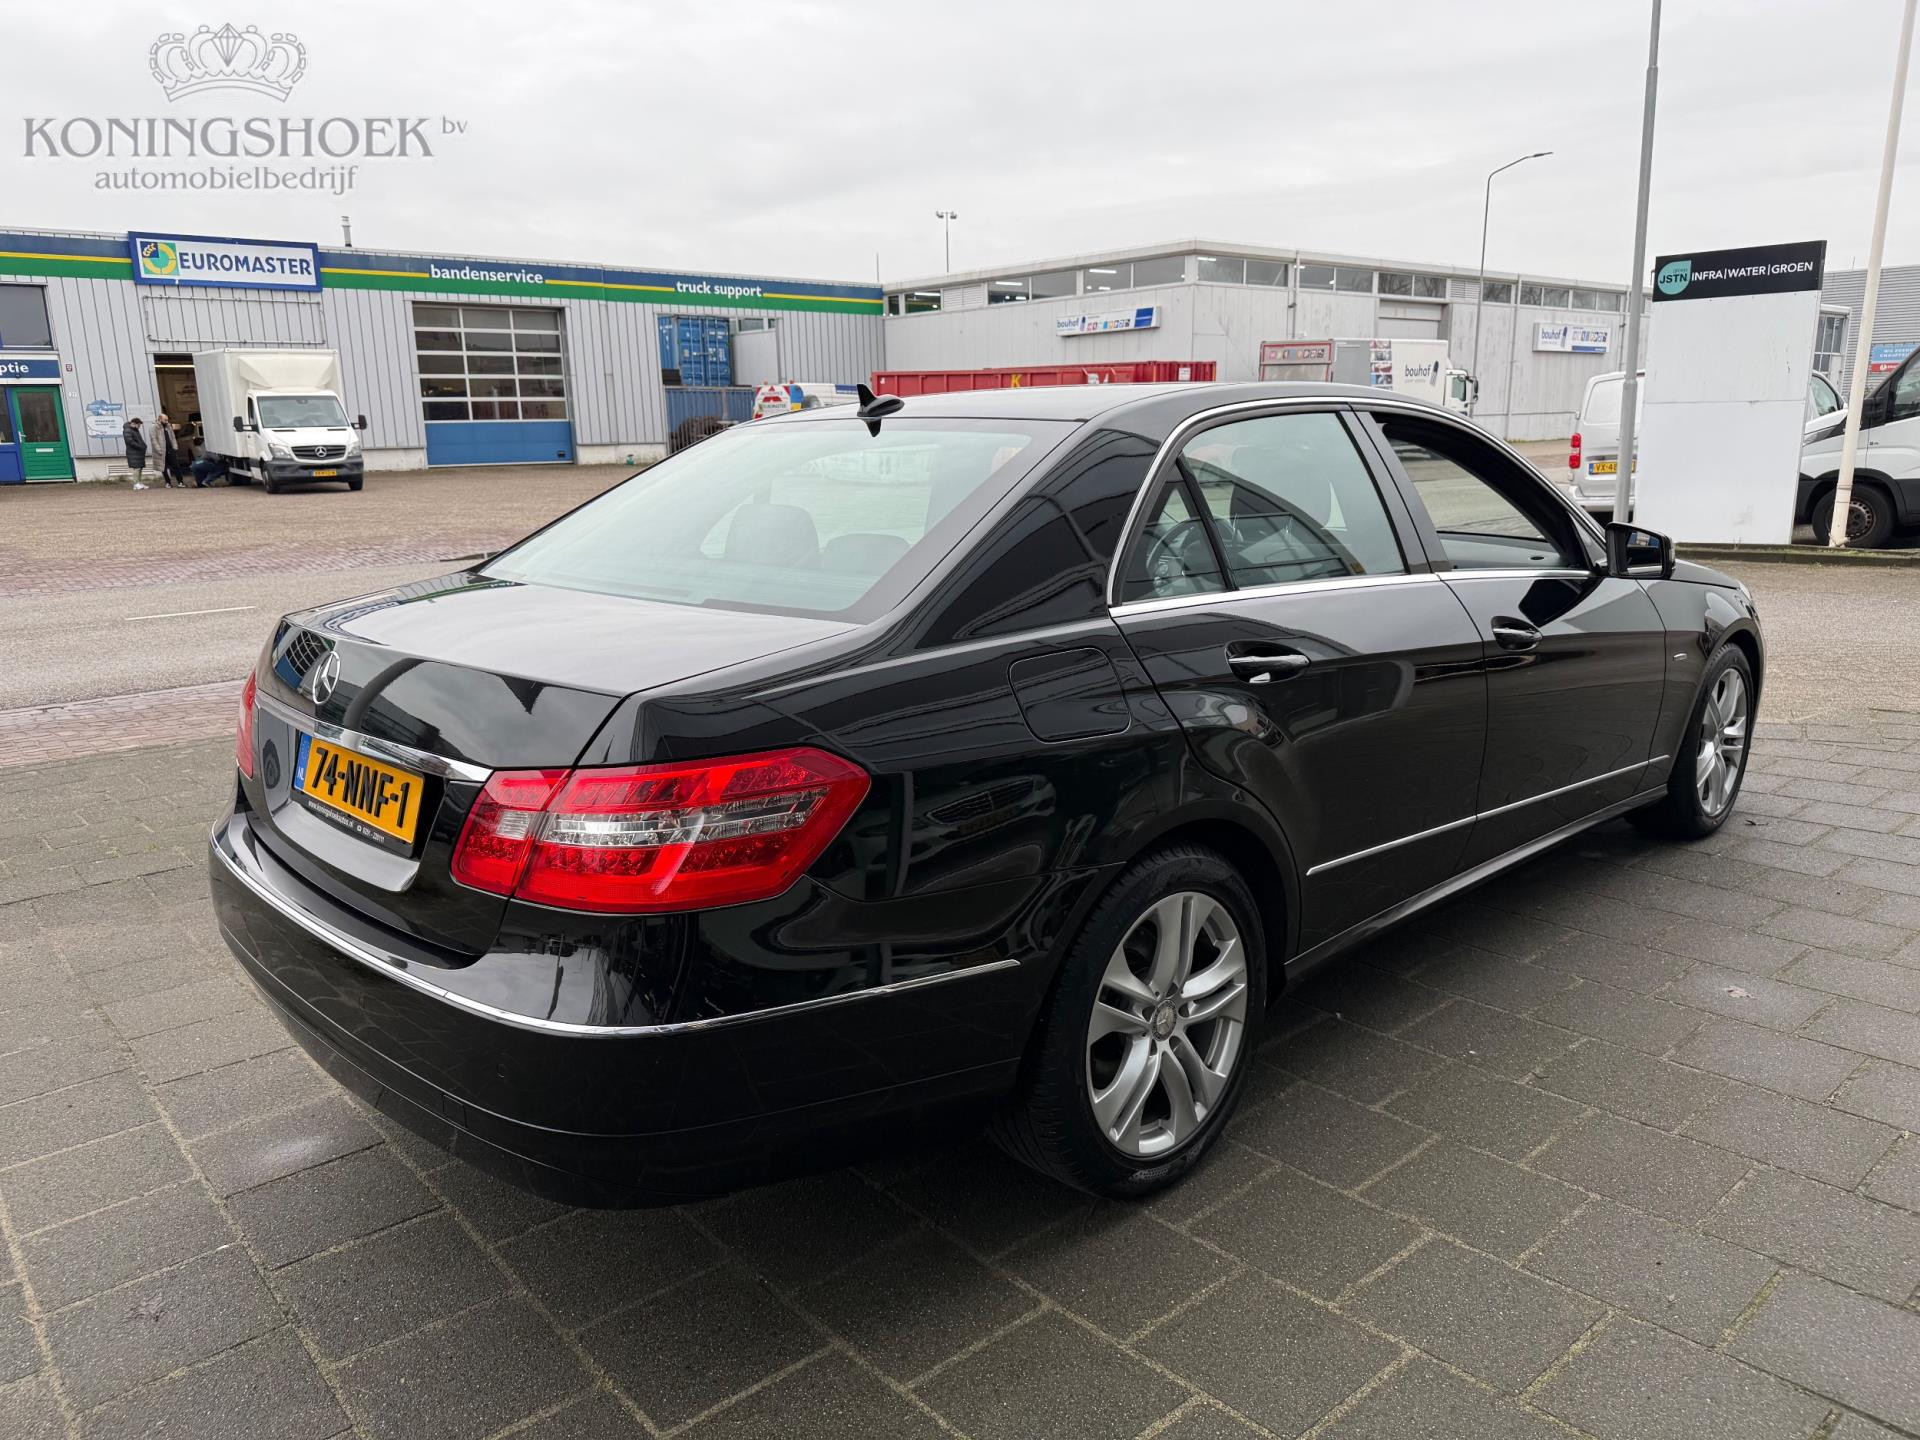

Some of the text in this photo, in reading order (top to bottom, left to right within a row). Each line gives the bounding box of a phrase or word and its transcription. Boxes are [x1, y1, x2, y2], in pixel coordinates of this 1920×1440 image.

[178, 251, 313, 276] EUROMASTER
[430, 263, 544, 284] bandenservice
[1659, 273, 1688, 284] JSTN
[676, 281, 762, 299] truck support
[0, 362, 29, 374] ptie
[311, 746, 411, 829] 74-NNF-1
